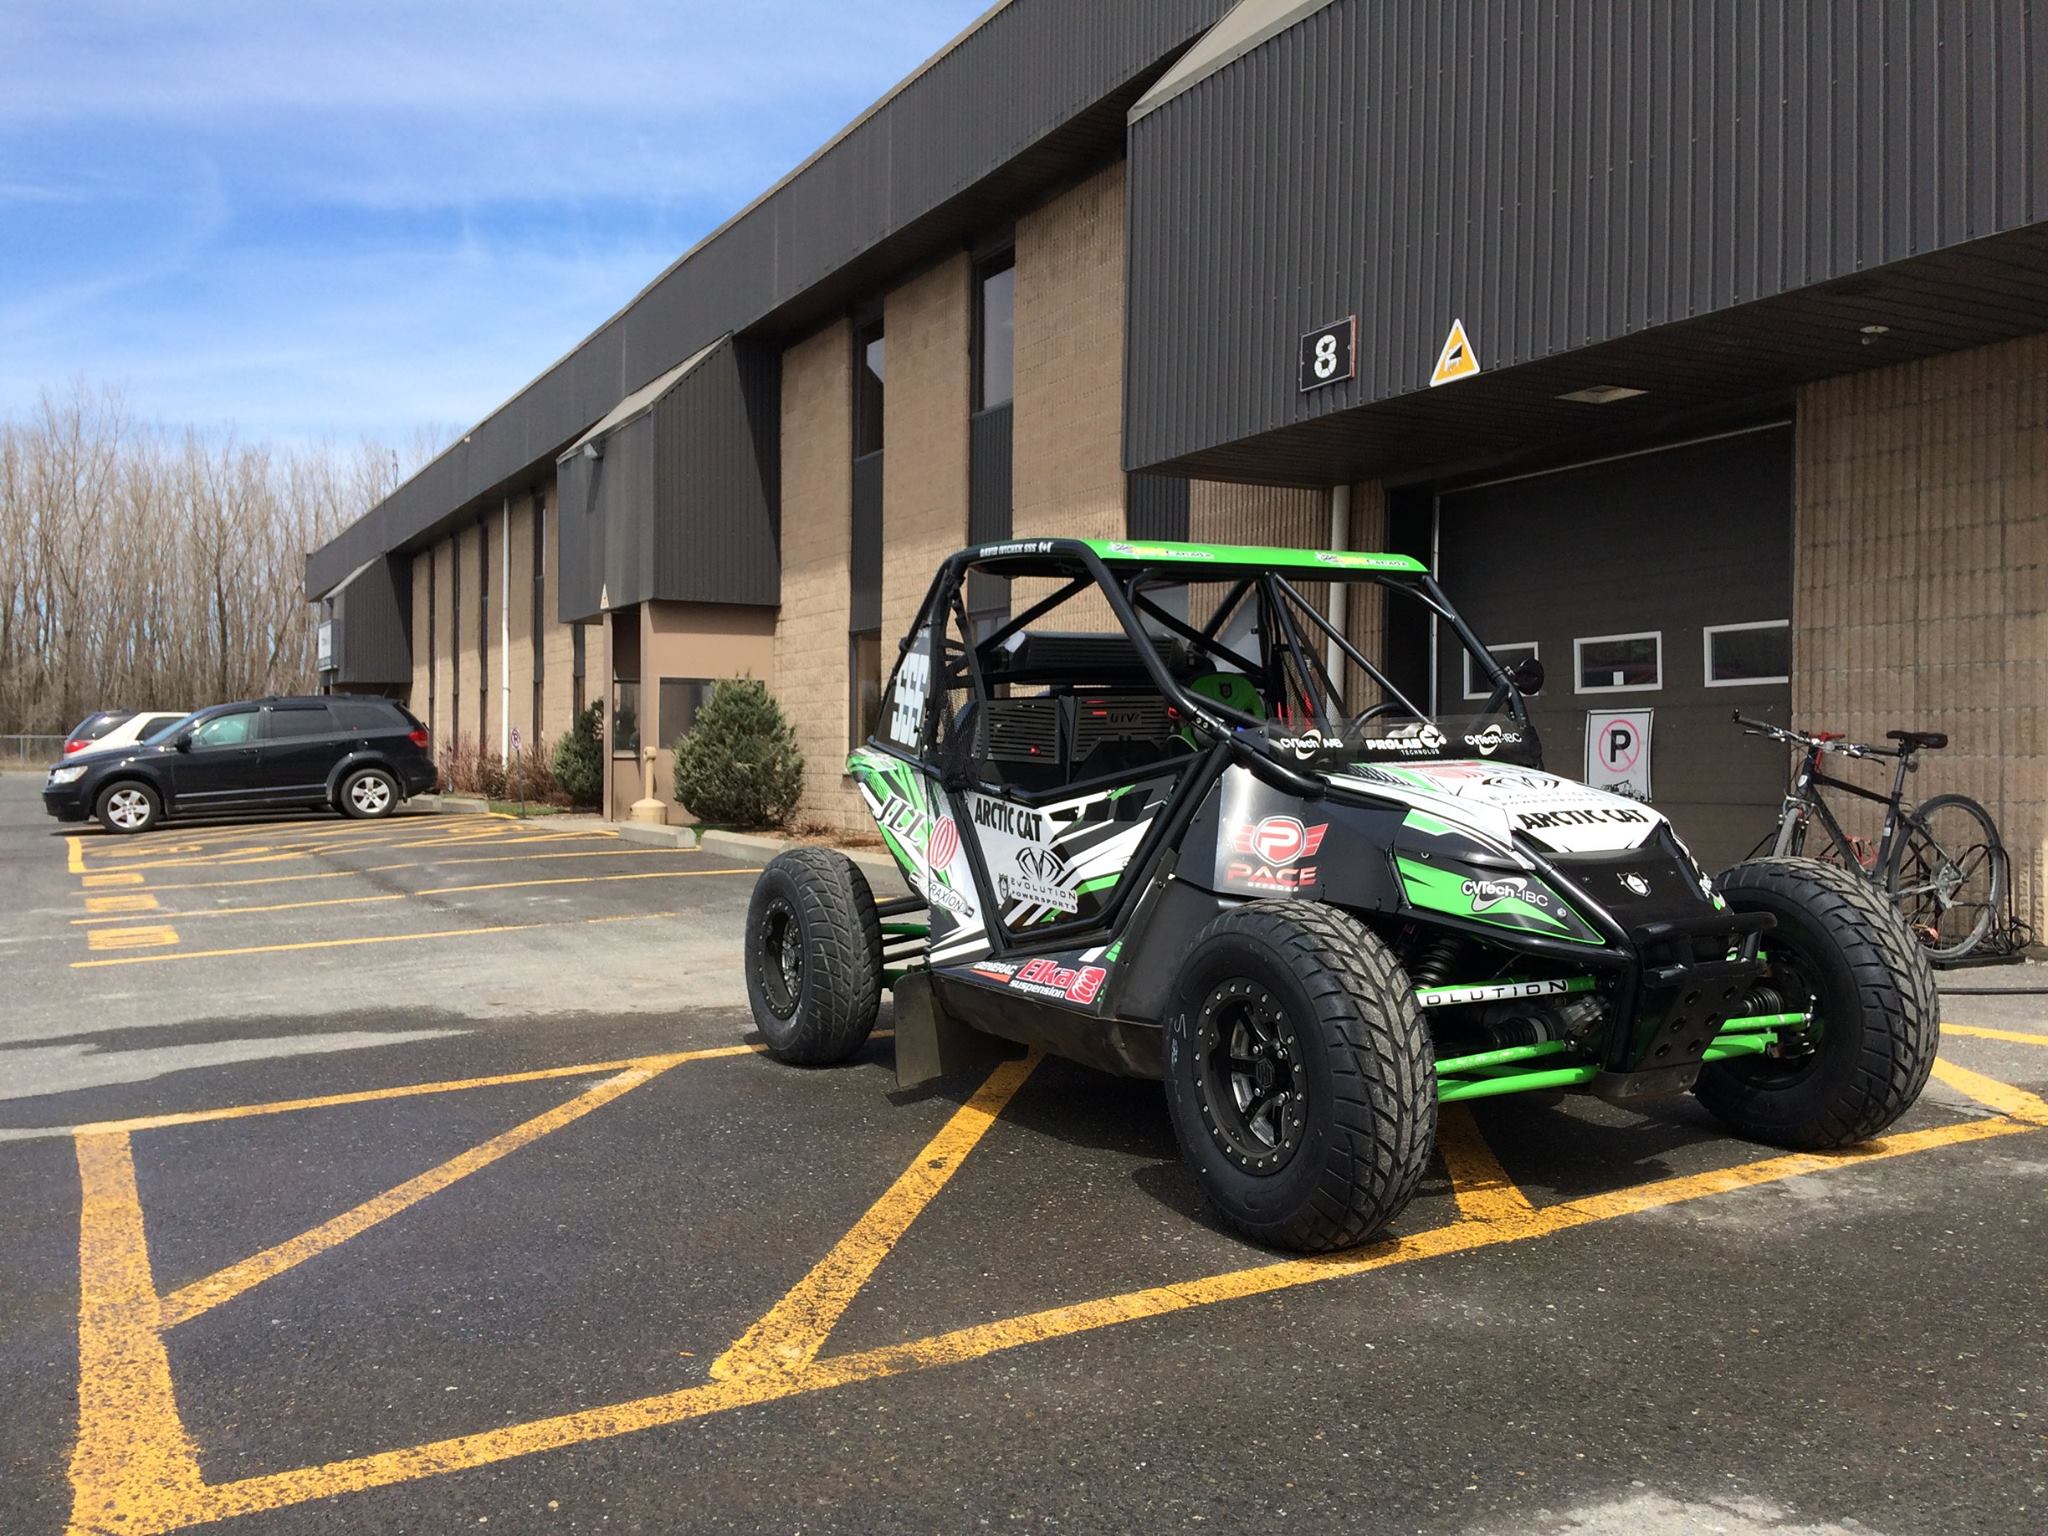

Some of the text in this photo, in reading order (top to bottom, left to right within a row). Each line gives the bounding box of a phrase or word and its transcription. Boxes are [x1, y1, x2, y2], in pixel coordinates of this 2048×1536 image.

[1314, 334, 1337, 379] 8
[1365, 738, 1424, 750] PROLAB
[974, 797, 1043, 842] ARCTIC CAT
[1516, 809, 1650, 830] ARCTIC CAT
[1227, 863, 1317, 887] PACE
[927, 883, 965, 912] RAXION
[1010, 877, 1076, 901] EVOLUTION
[1012, 889, 1076, 911] POWERSPORTS
[1016, 958, 1077, 989] Elka
[1008, 980, 1066, 999] suspension
[1426, 979, 1568, 1006] OLUTION
